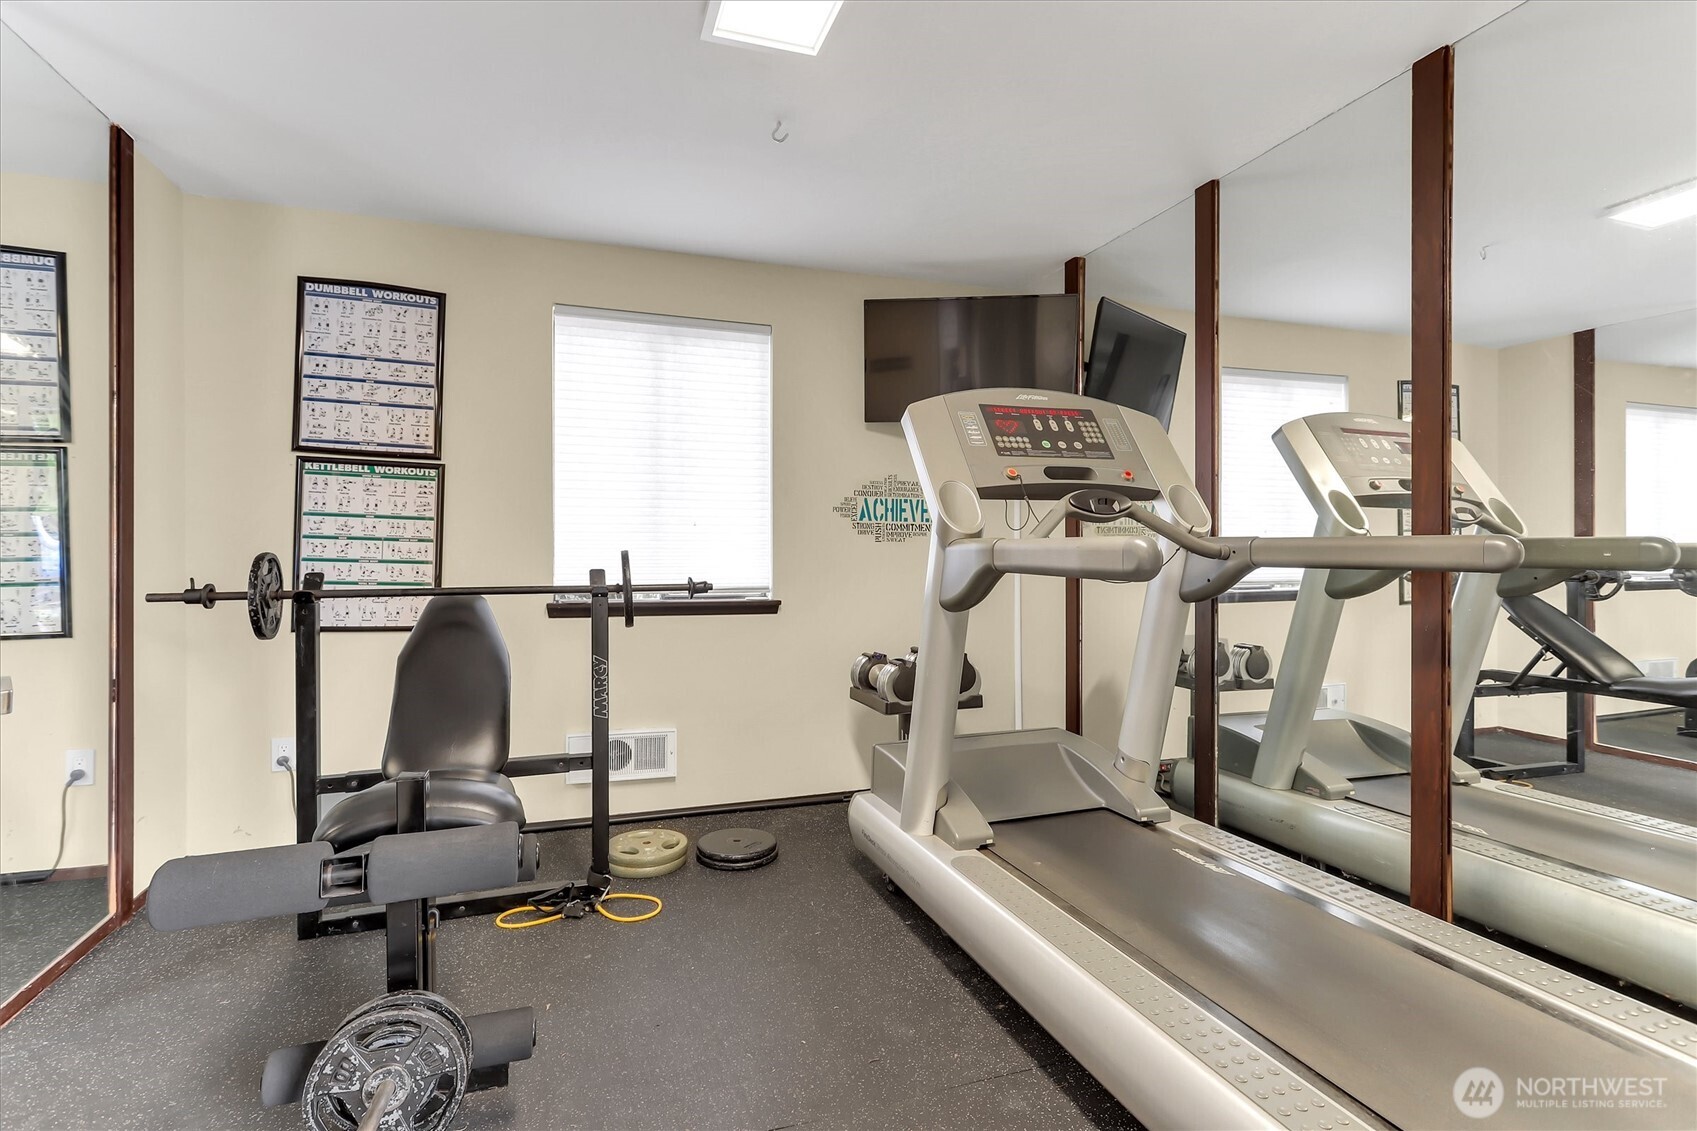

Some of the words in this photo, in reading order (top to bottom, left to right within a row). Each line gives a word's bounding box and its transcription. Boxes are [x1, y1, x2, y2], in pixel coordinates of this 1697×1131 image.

[305, 282, 368, 297] DUMBBELL
[372, 289, 437, 305] WORKOUTS
[304, 462, 370, 473] KETTLEBELL
[374, 465, 437, 476] WORKOUTS
[858, 497, 932, 523] ACHIEVE
[852, 522, 875, 530] STRONG
[874, 522, 882, 543] PUSH
[885, 523, 932, 532] COMMITMEN
[592, 654, 608, 719] MARCY
